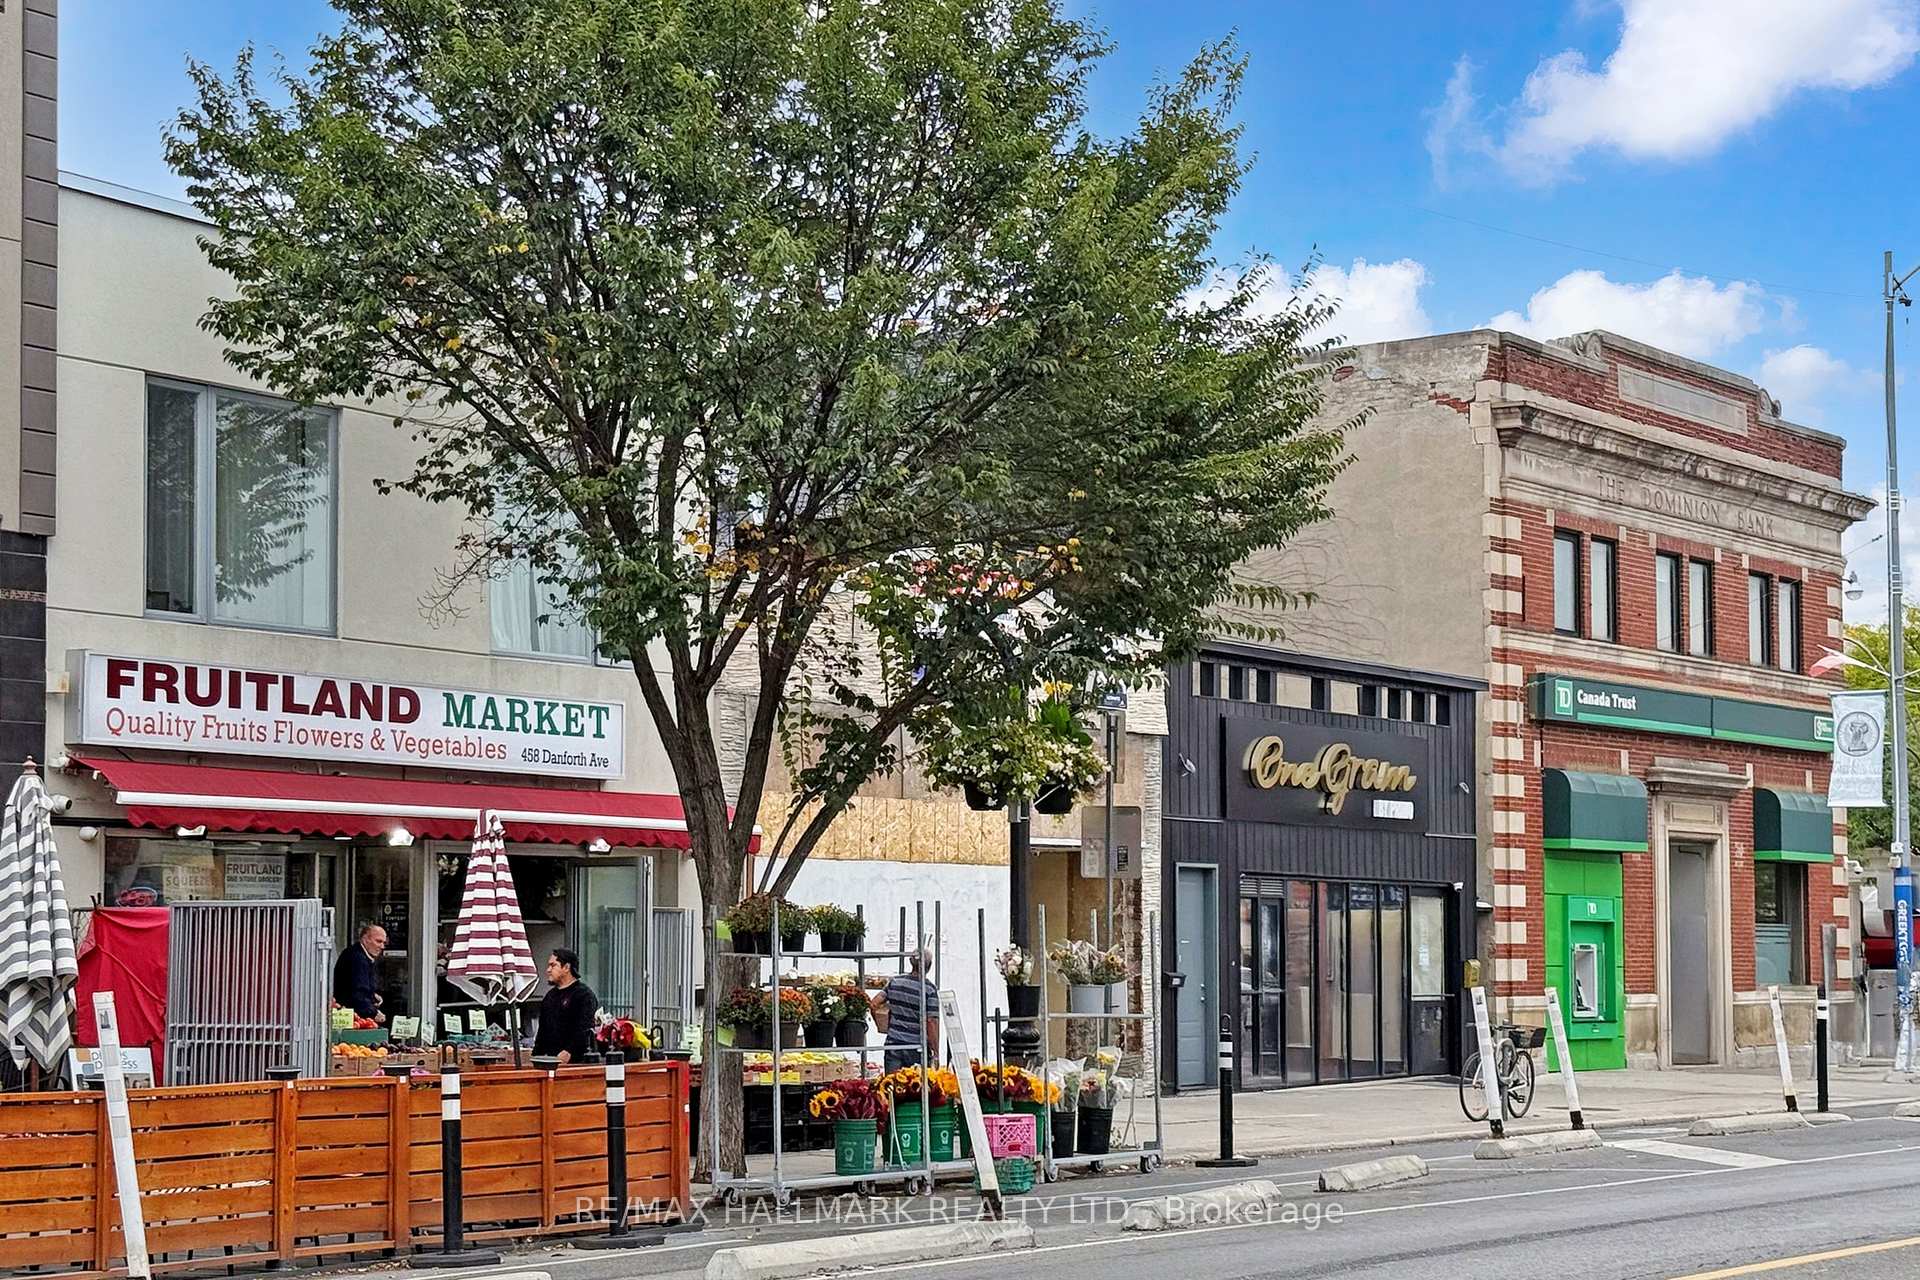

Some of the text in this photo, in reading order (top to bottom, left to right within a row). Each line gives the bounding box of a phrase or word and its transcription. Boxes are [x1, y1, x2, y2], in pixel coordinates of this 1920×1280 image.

[1597, 474, 1776, 538] THE DOMINION BANK
[106, 658, 611, 739] FRUITLAND MARKET
[1577, 688, 1611, 708] Canada
[1611, 693, 1637, 711] Trust
[106, 707, 508, 760] Quality Fruits Flowers & Vegetables
[520, 747, 610, 769] 458 Danforth Ave
[226, 863, 283, 876] FRUITLAND
